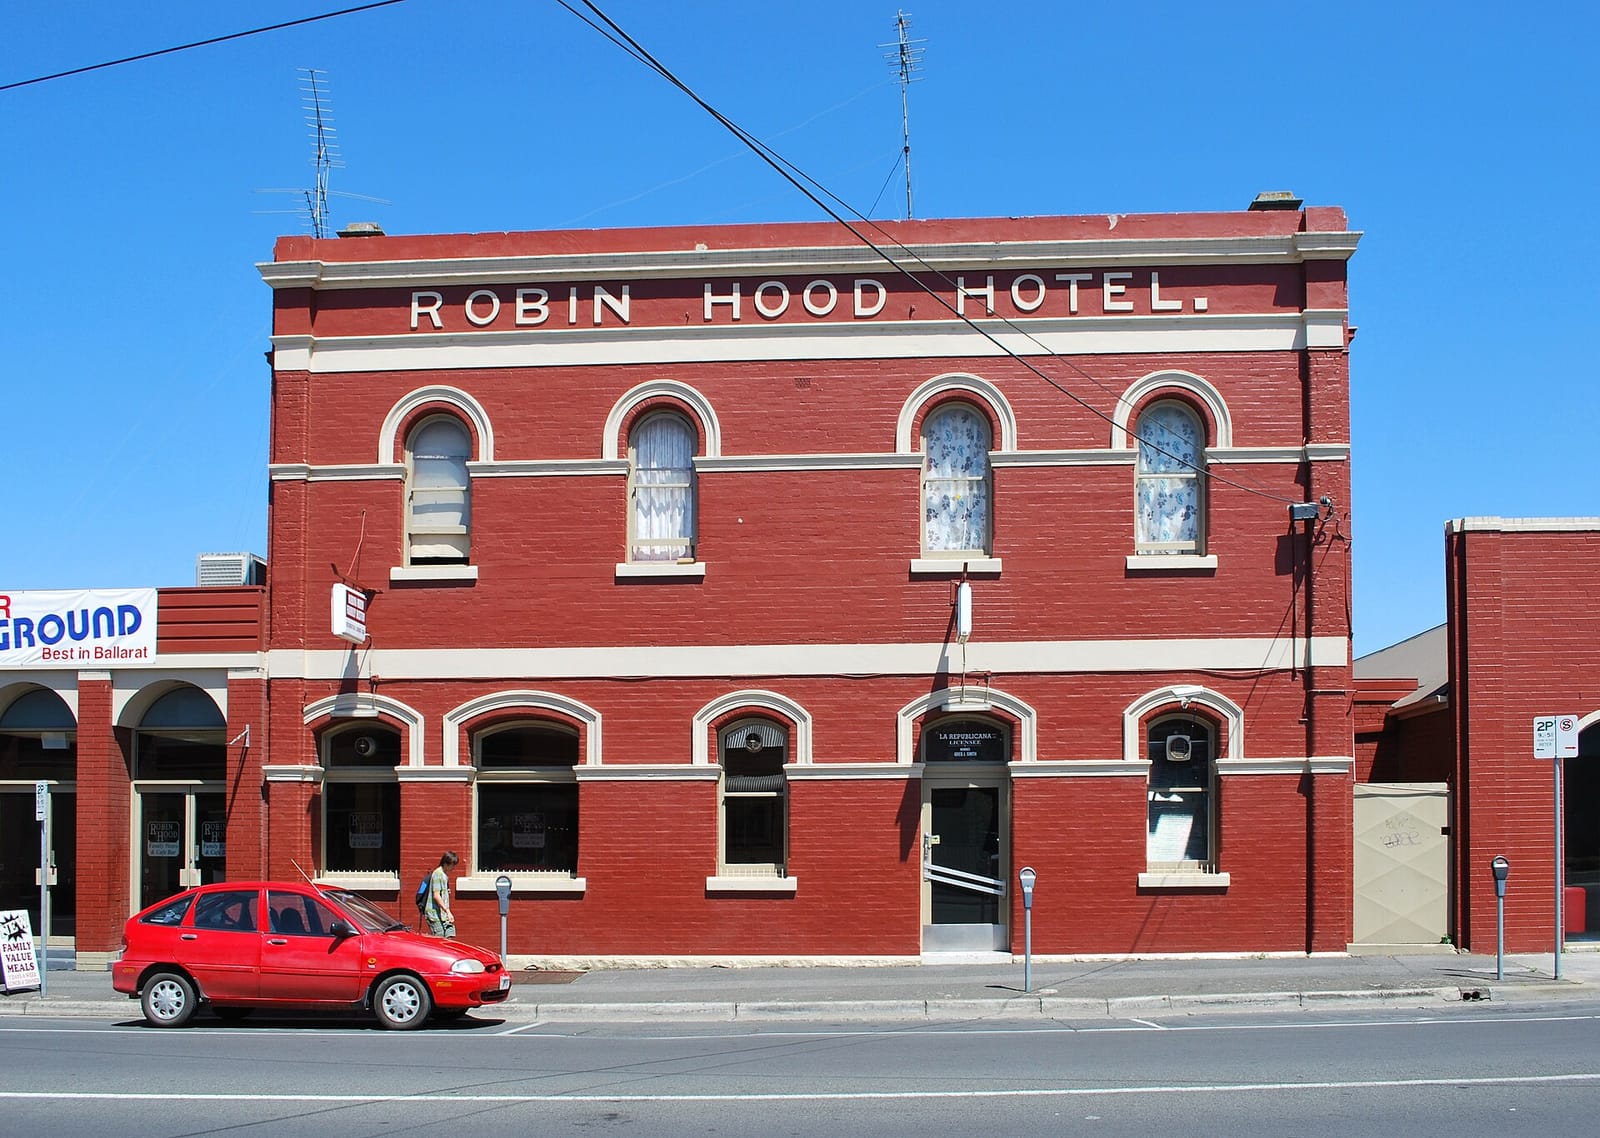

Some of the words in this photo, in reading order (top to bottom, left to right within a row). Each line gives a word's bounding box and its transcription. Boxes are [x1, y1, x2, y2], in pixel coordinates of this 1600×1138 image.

[410, 284, 631, 329] ROBIN
[703, 278, 887, 321] HOOD
[956, 271, 1209, 317] HOTEL.
[42, 647, 74, 660] Best
[79, 646, 90, 659] in
[94, 645, 148, 659] Ballarat
[1536, 721, 1554, 731] 2P
[948, 732, 992, 740] REPUBLICANA
[2, 942, 32, 953] FAMILY
[6, 952, 33, 963] VALUE
[7, 962, 35, 973] MEALS
